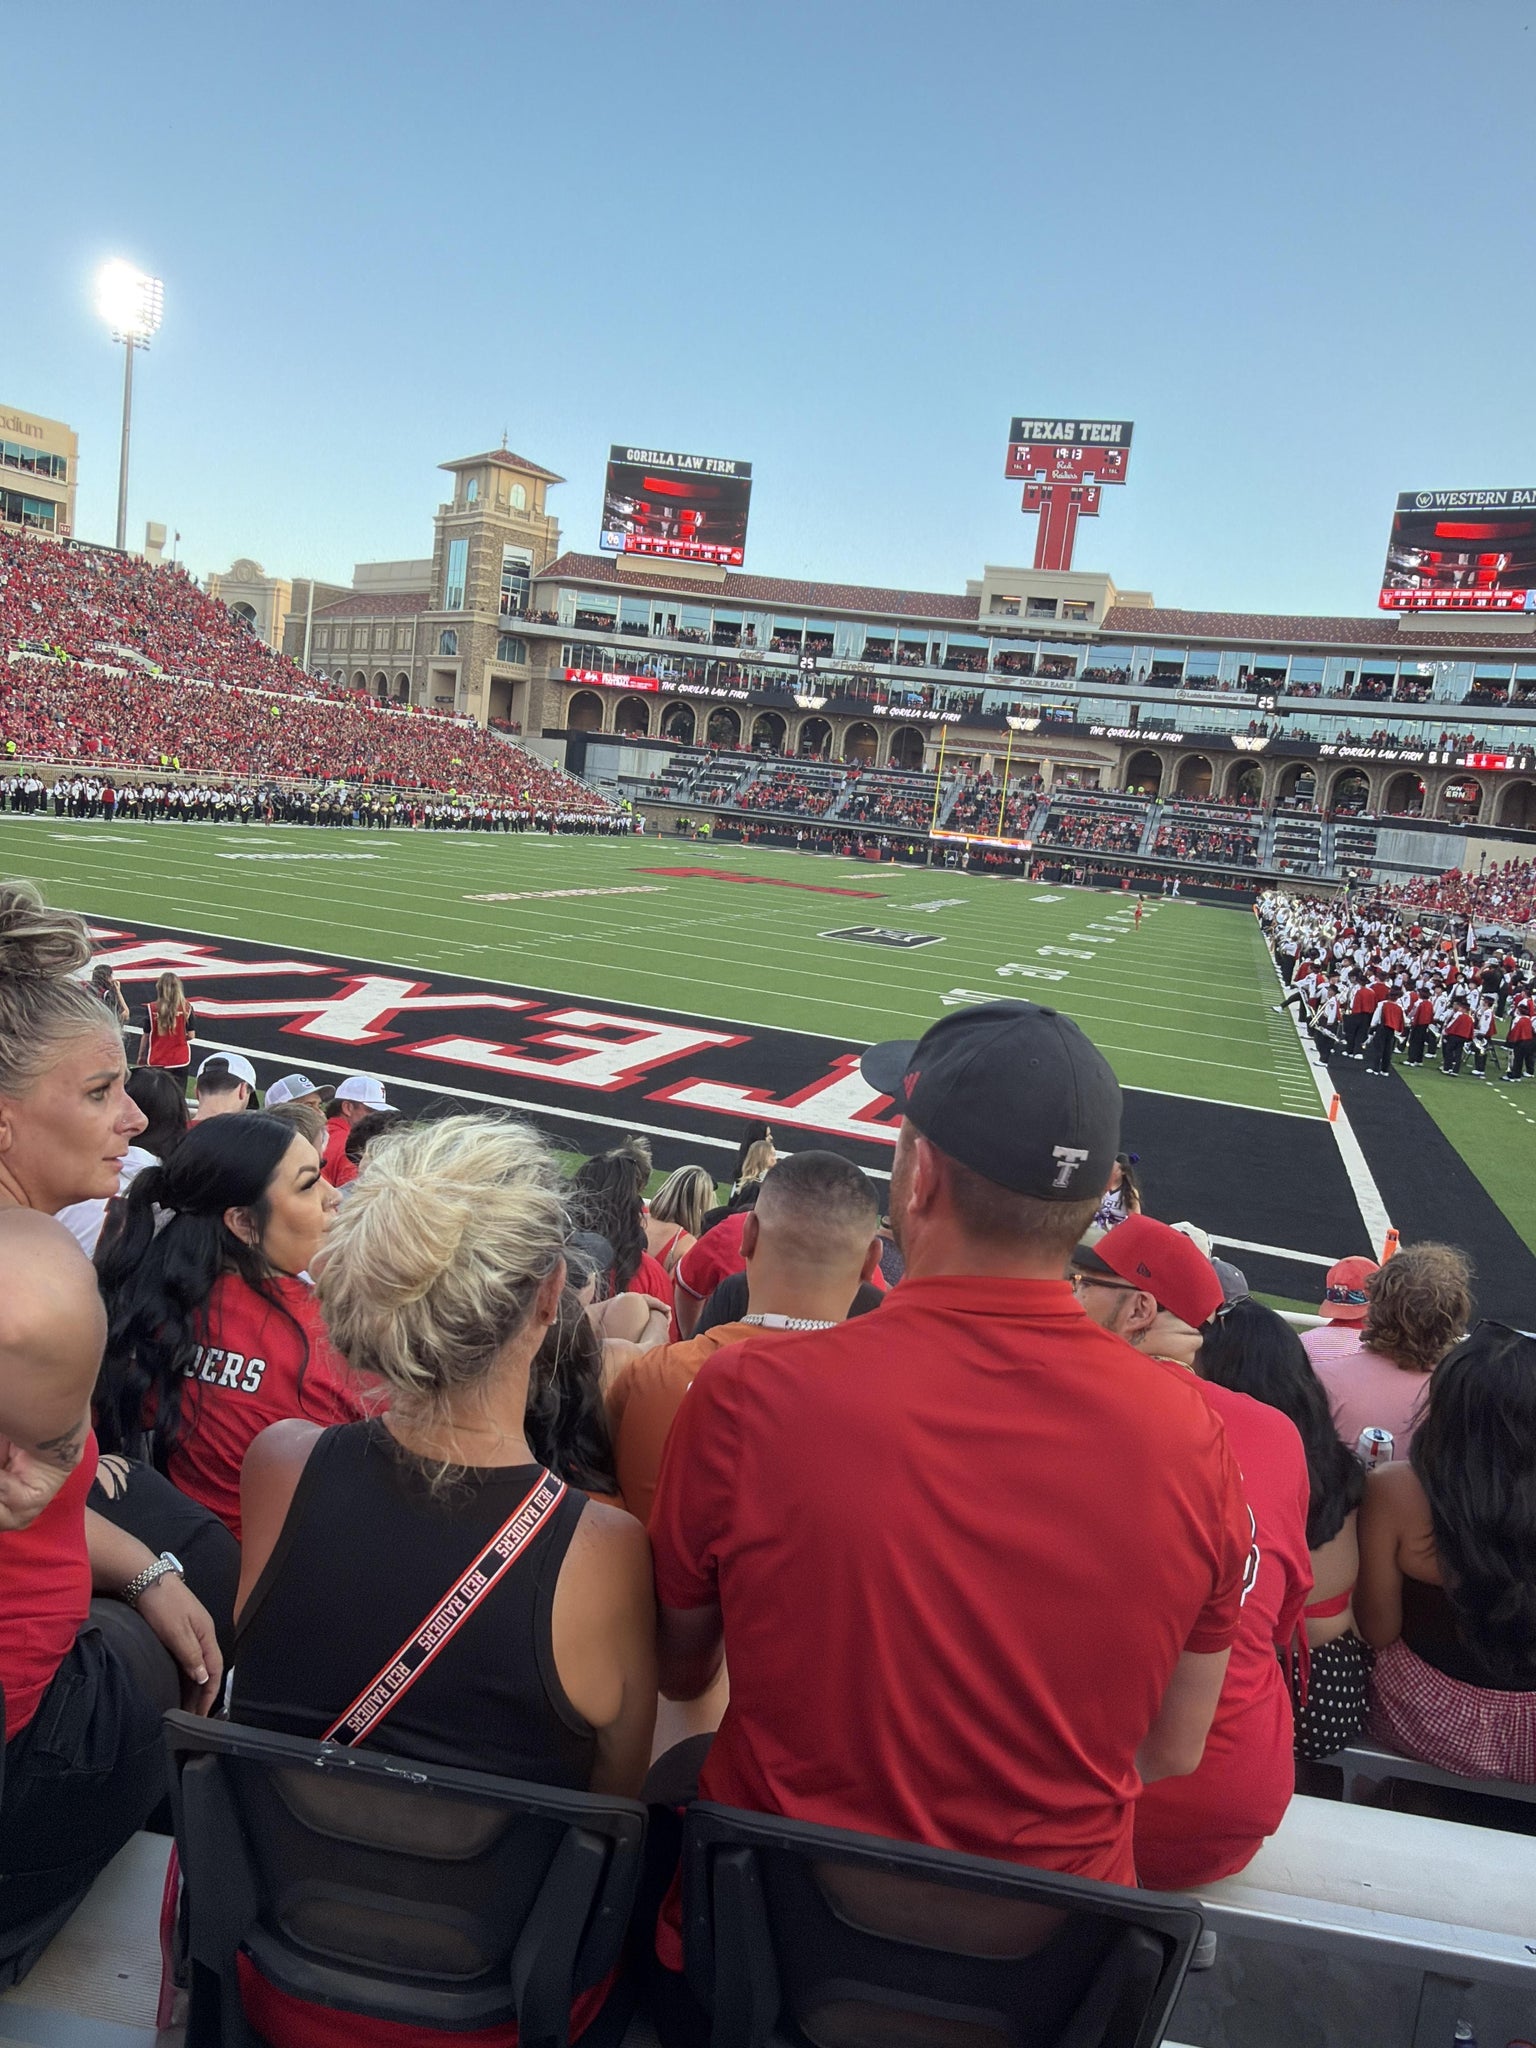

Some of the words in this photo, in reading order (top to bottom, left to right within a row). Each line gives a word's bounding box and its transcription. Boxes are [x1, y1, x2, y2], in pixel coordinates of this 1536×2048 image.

[1021, 421, 1075, 440] TEXAS
[1080, 423, 1122, 443] TECH
[626, 449, 675, 466] GORILLA
[677, 456, 704, 469] LAW
[705, 460, 736, 474] FIRM
[1055, 448, 1083, 460] 19:13
[1088, 492, 1095, 501] 2
[1435, 490, 1507, 506] WESTERN
[800, 657, 814, 669] 25
[841, 661, 875, 673] FireBird
[661, 681, 675, 691] THE
[677, 683, 710, 696] GORILLA
[711, 688, 728, 697] LAW
[728, 688, 749, 700] FIRM
[1019, 679, 1048, 689] DOUBLE
[1050, 681, 1074, 690] EAGLE
[1258, 696, 1275, 709] 25
[872, 704, 888, 714] THE
[888, 706, 922, 719] GORILLA
[922, 709, 939, 719] LAW
[940, 711, 962, 722] FIRM
[1089, 725, 1106, 736] THE
[1106, 726, 1141, 739] GORILLA
[1142, 729, 1160, 741] LAW
[1161, 732, 1184, 743] FIRM
[1319, 744, 1337, 755] THE
[1338, 746, 1376, 759] GORILLA
[1377, 748, 1398, 759] LAW
[1398, 750, 1424, 762] FIRM
[534, 1486, 555, 1510] RED
[494, 1504, 541, 1558] RAIDERS
[460, 1569, 488, 1600] RED
[417, 1592, 466, 1652] RAIDERS
[384, 1661, 412, 1690] RED
[346, 1684, 392, 1733] RAIDERS
